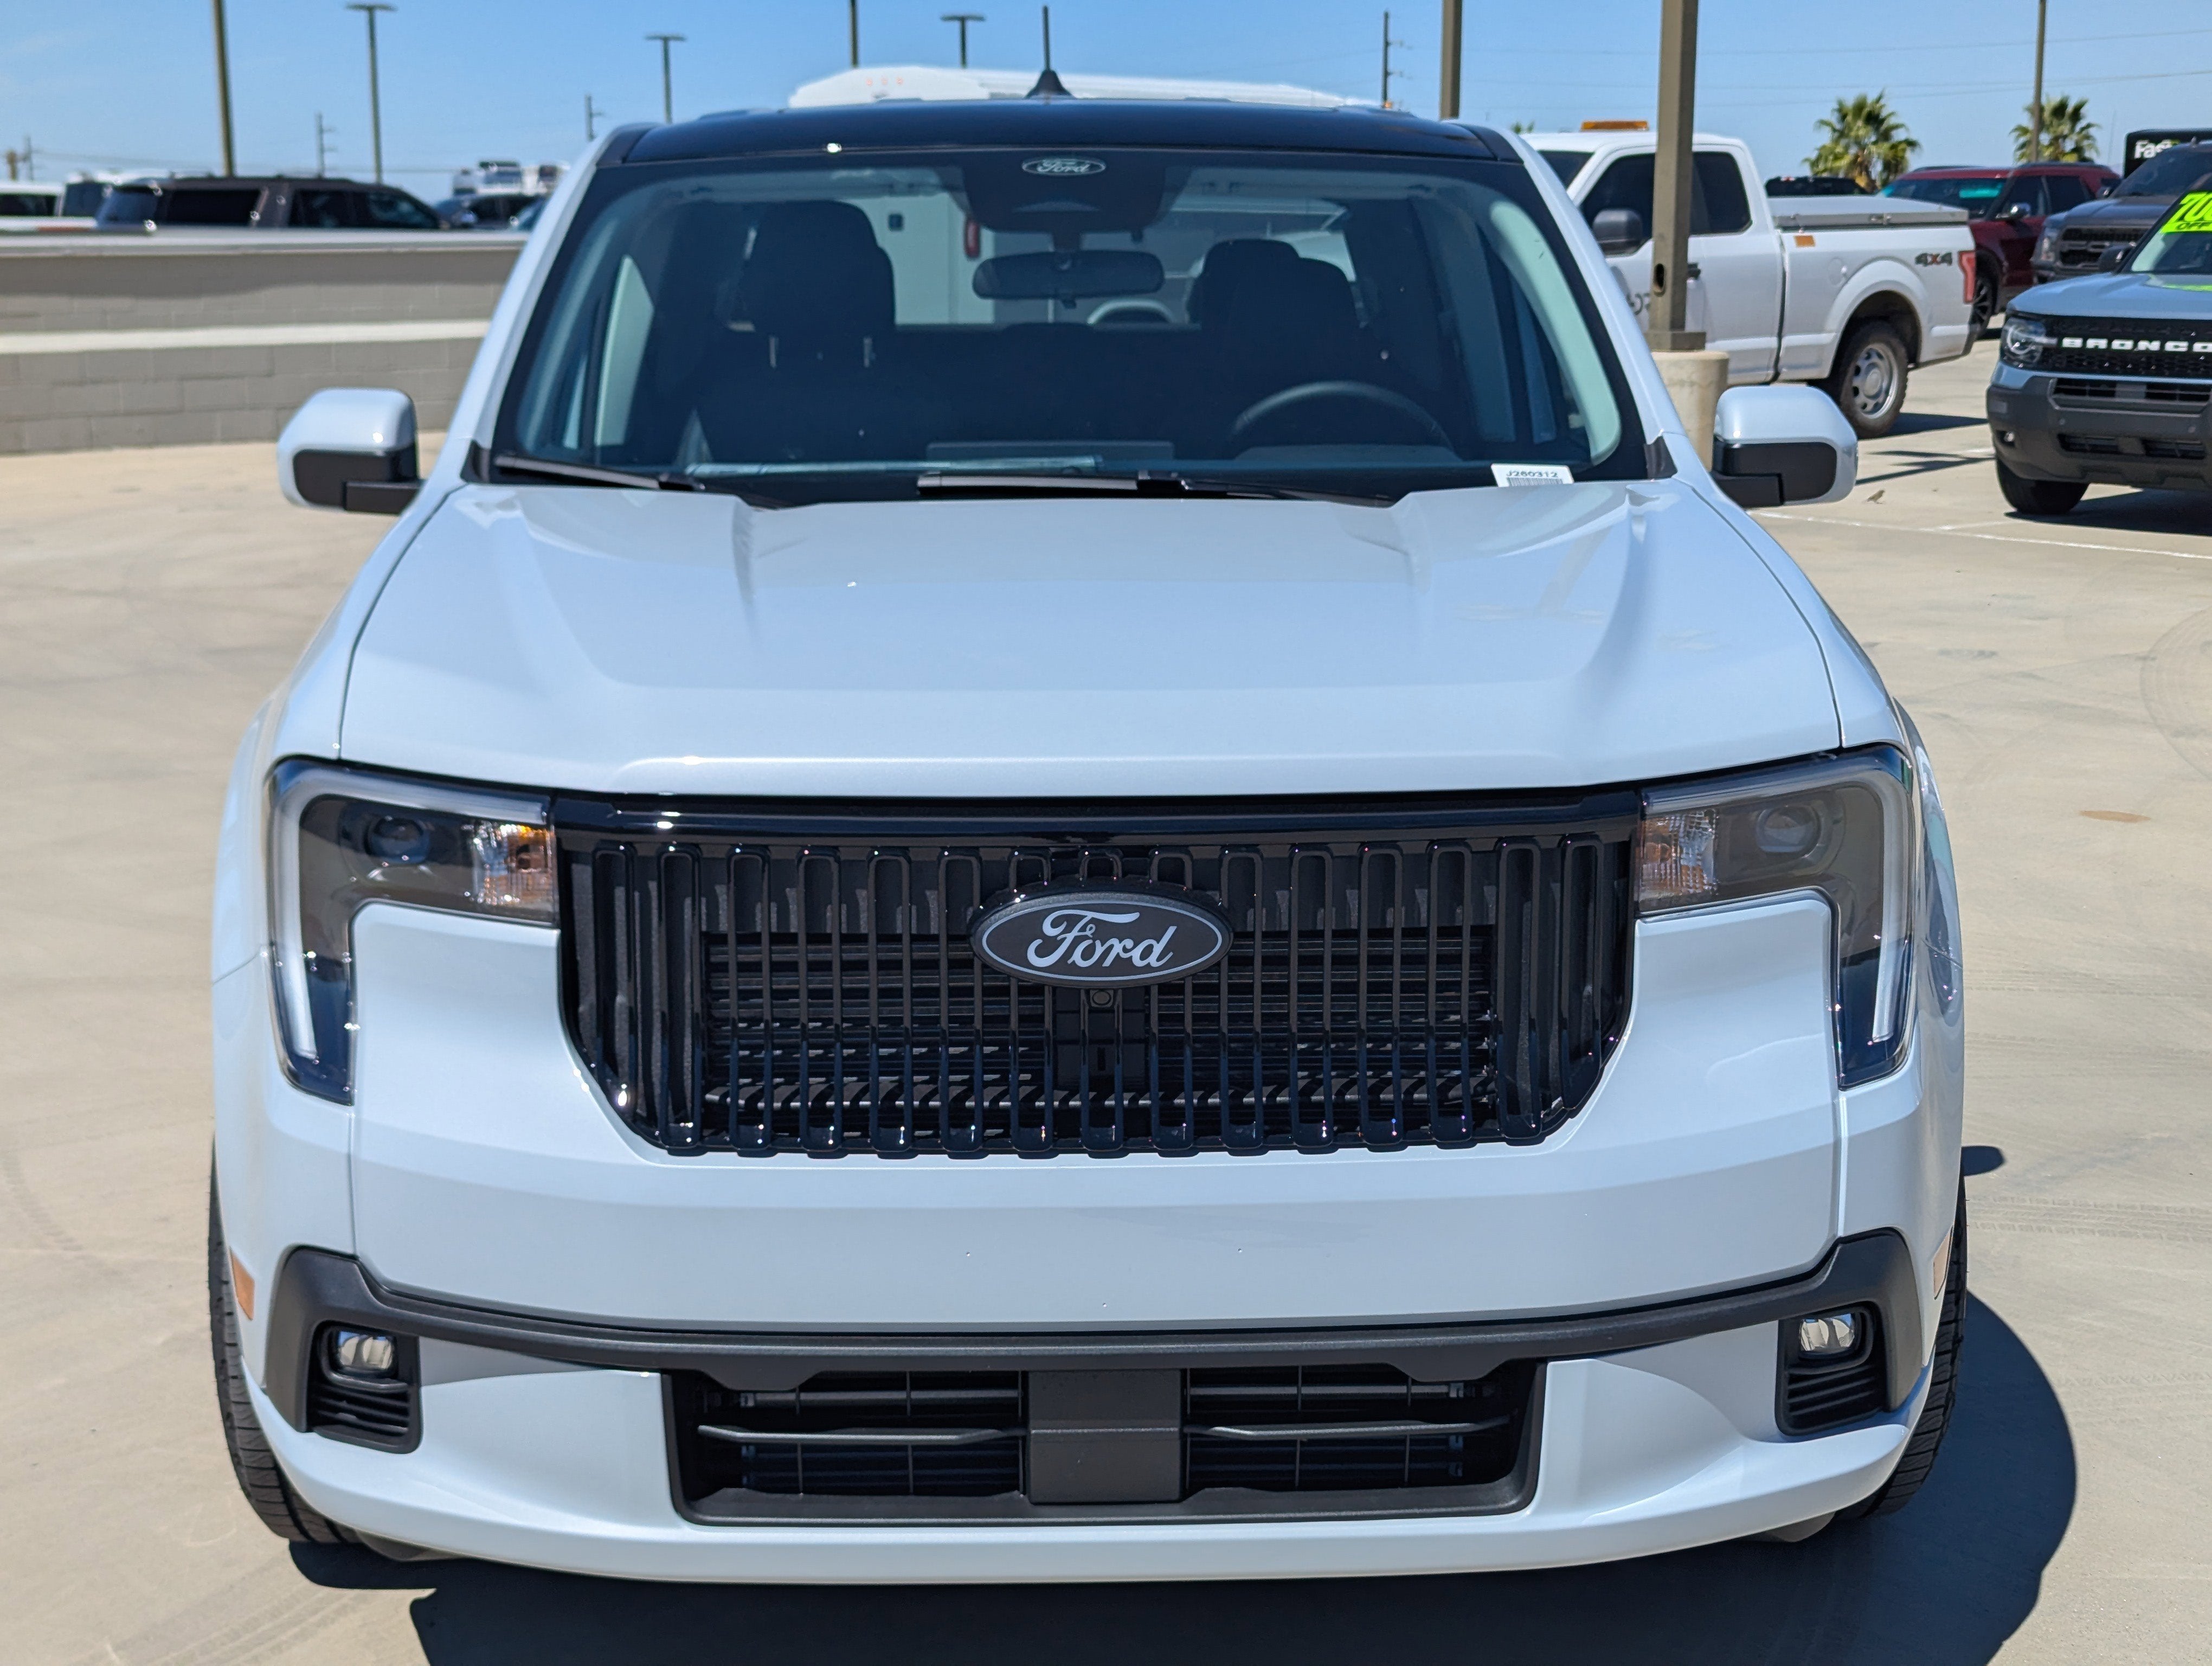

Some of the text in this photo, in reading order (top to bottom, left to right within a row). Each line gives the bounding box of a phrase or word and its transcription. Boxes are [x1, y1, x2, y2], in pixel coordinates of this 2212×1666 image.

[1037, 159, 1090, 172] Ford
[2062, 337, 2212, 353] BRONCO
[1027, 909, 1178, 967] Ford
